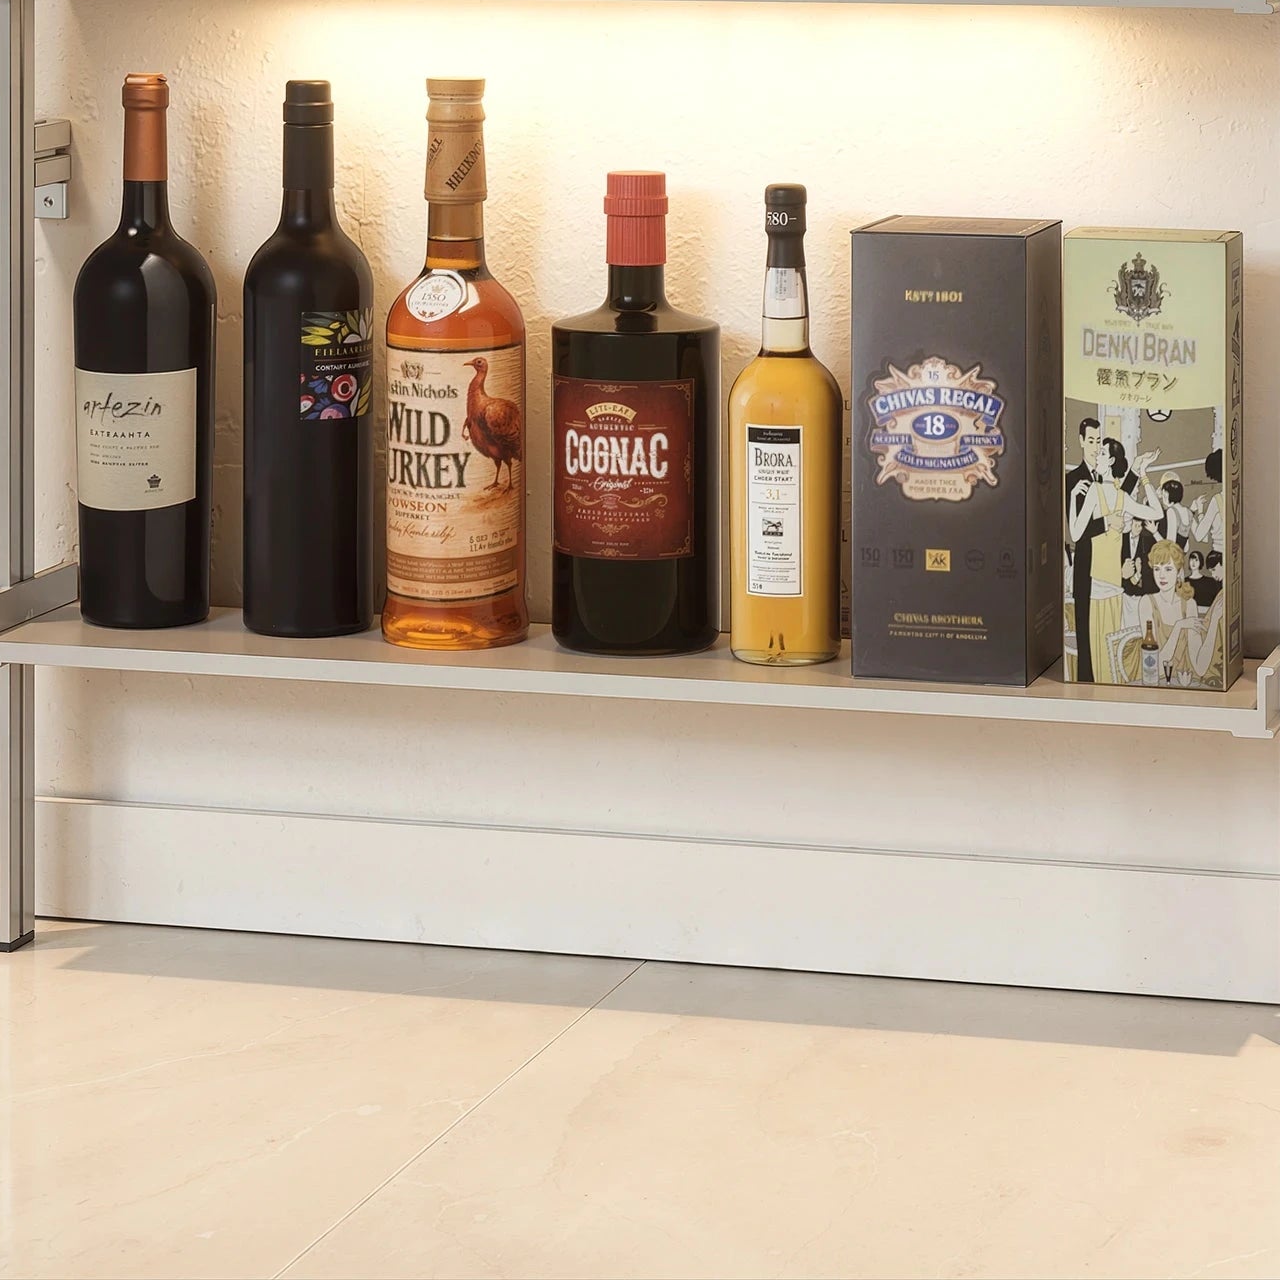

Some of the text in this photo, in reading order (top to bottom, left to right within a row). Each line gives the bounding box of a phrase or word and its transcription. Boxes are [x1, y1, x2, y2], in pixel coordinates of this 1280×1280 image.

[1083, 328, 1197, 368] DENKI BRAN
[875, 388, 997, 417] CHIVAS REGAL
[389, 400, 451, 447] WILD
[923, 414, 946, 436] 18
[566, 428, 668, 479] COGNAC
[754, 447, 793, 467] BRORA
